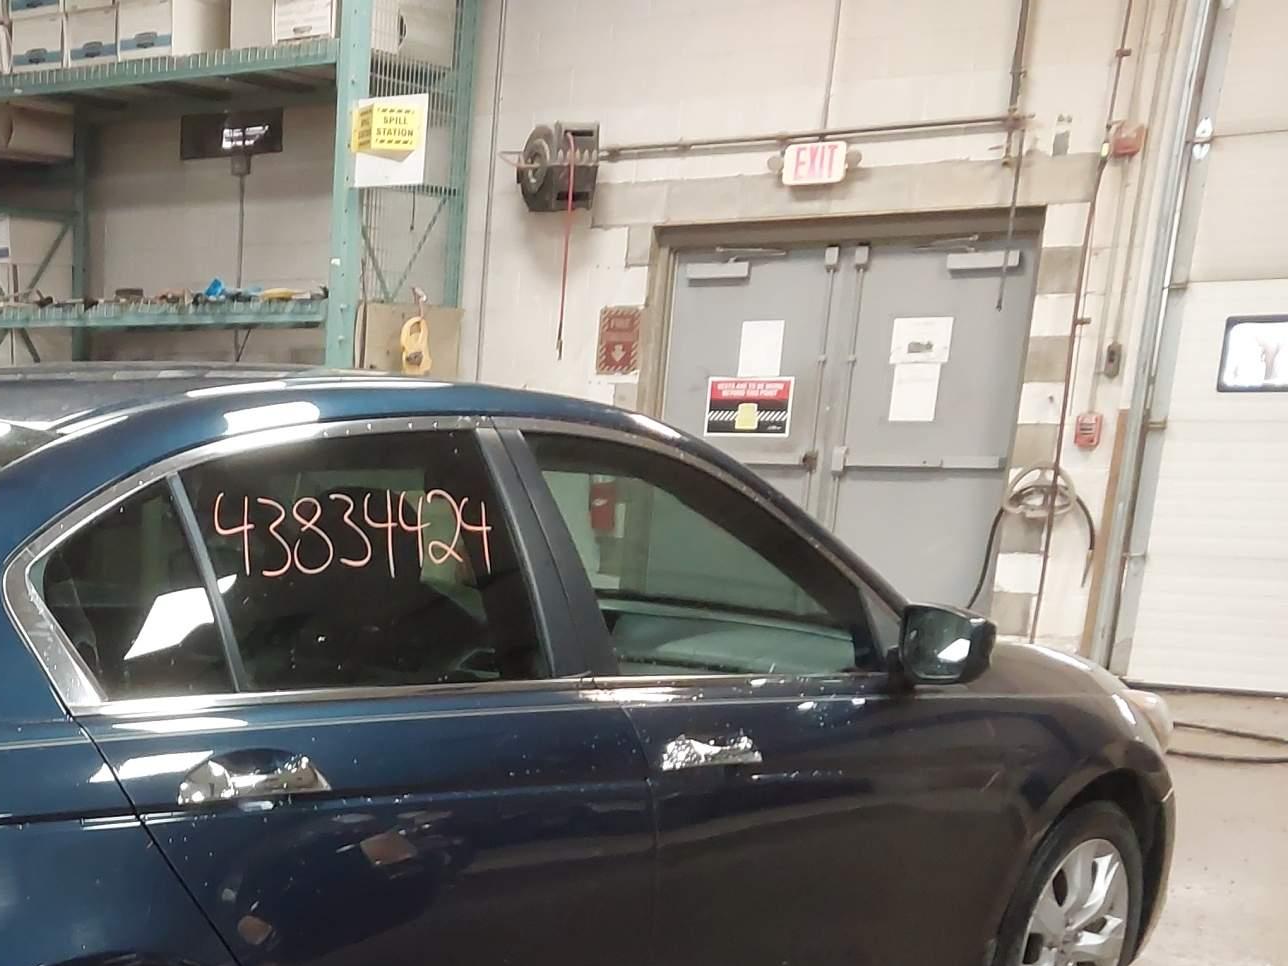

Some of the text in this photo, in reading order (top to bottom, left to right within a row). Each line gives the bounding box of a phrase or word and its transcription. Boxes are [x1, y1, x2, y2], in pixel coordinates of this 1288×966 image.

[383, 116, 408, 125] SPILL
[376, 128, 414, 137] STATION
[793, 145, 839, 179] EXIT
[214, 489, 492, 579] 43834424
